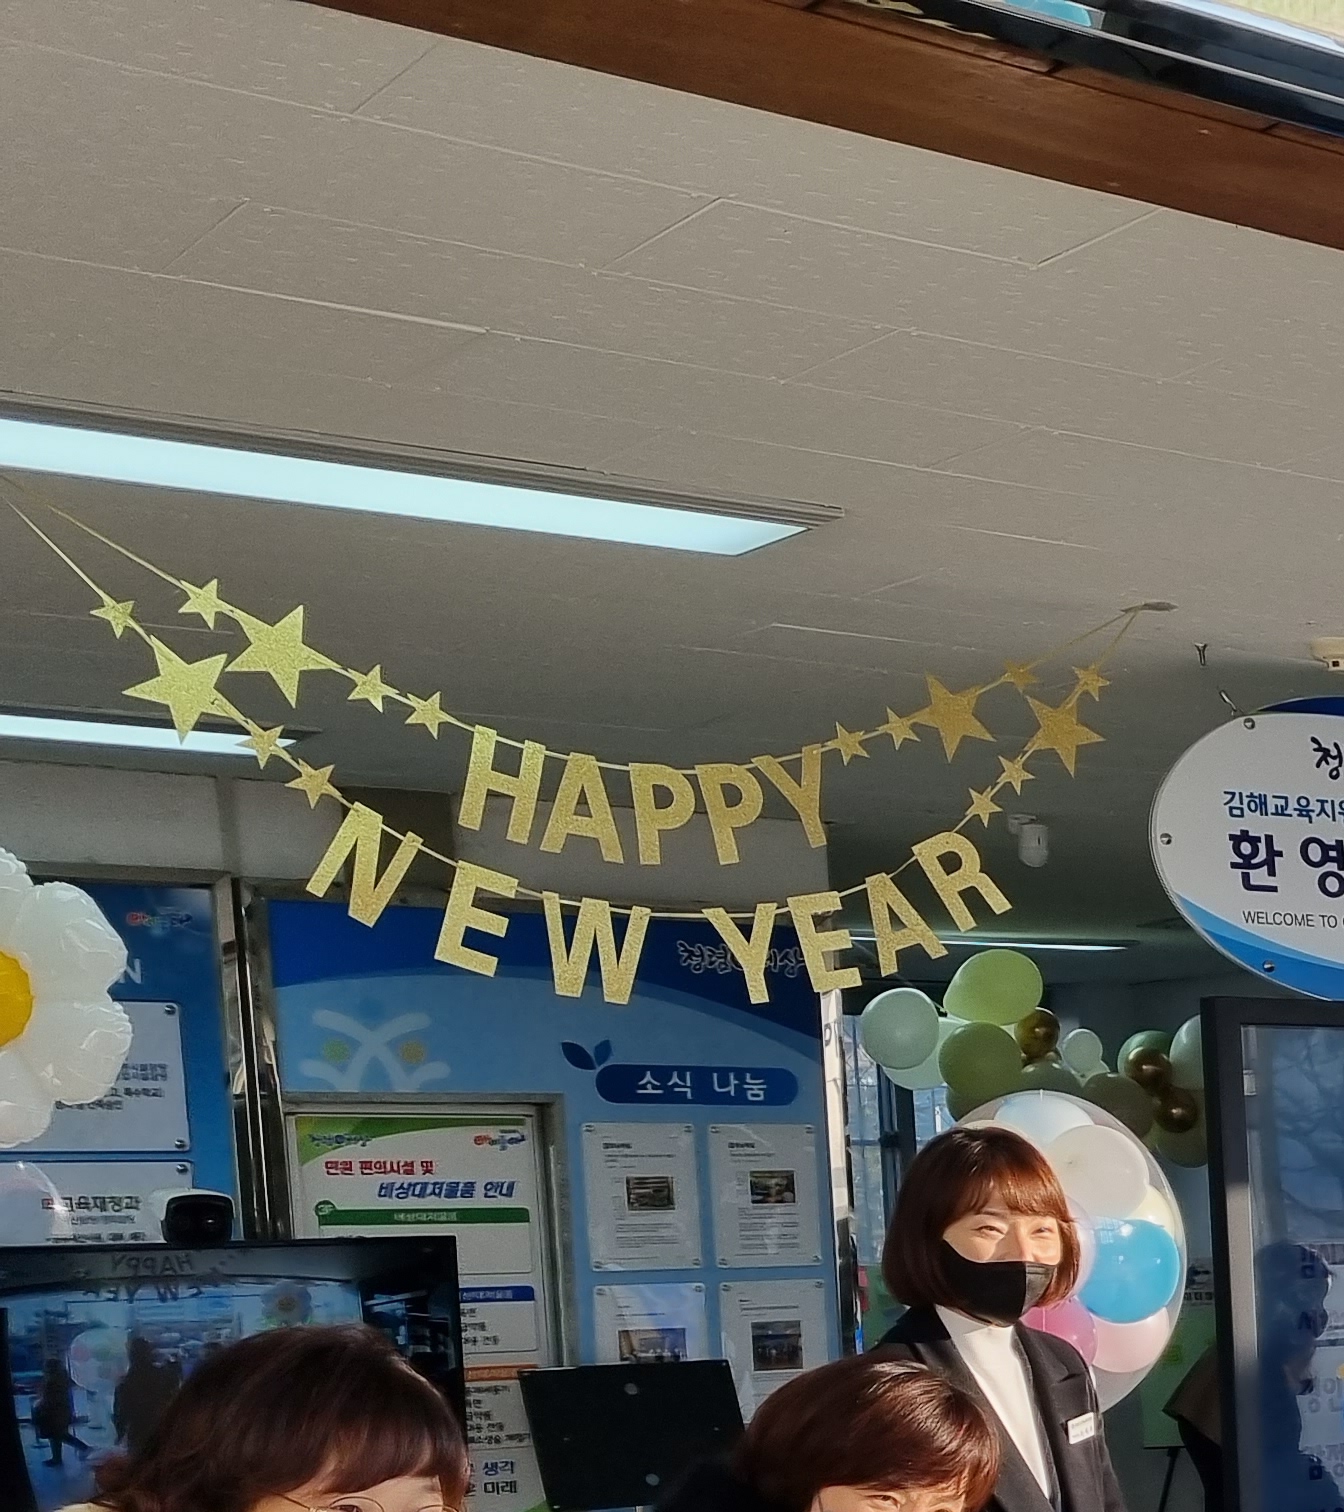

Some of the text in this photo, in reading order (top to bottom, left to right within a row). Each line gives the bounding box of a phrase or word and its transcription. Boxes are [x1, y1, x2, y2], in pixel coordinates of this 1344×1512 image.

[458, 724, 828, 865] HAPPY
[305, 801, 1013, 1005] NEW YEAR
[1243, 910, 1315, 928] WELCOME
[1319, 914, 1338, 929] TO
[636, 1071, 768, 1101] 소식 나눔
[324, 1160, 355, 1176] 민원
[359, 1160, 415, 1176] 편의시설
[483, 1180, 517, 1199] 안내
[482, 1460, 515, 1477] 생각
[483, 1480, 518, 1496] 미래
